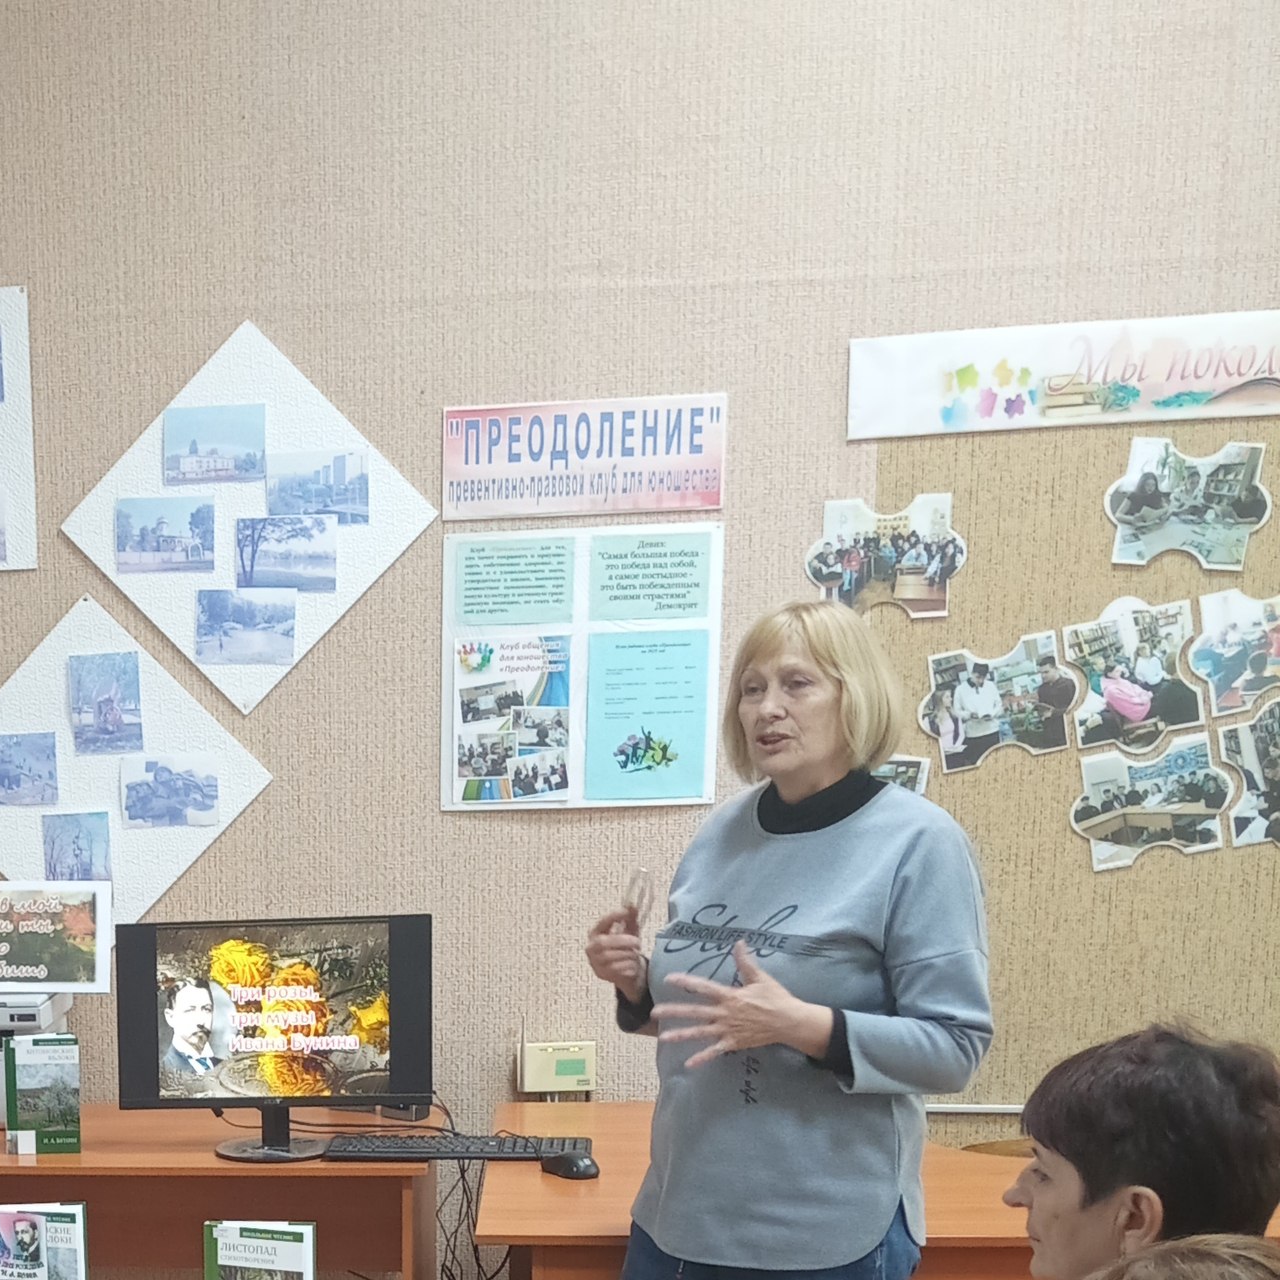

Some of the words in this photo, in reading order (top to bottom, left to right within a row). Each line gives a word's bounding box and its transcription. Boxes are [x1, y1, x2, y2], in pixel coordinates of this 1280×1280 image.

[1047, 333, 1148, 391] Мы
[1165, 343, 1280, 381] покол
[449, 407, 720, 471] "ПРЕОДОЛЕНИЕ"
[448, 468, 585, 510] превентивно-правовой
[589, 464, 618, 503] клуб
[621, 470, 643, 494] для
[647, 467, 719, 493] юношества
[630, 551, 667, 559] большая
[670, 550, 699, 558] победа
[621, 561, 650, 569] победа
[653, 561, 668, 570] над
[670, 560, 697, 568] собой,
[639, 581, 700, 590] побежденным
[642, 591, 691, 600] страстями"
[655, 602, 698, 611] Демокрит
[499, 642, 520, 651] Клуб
[13, 896, 63, 913] мой
[19, 920, 54, 934] ты
[671, 924, 719, 943] FASHION
[746, 932, 789, 948] STYLE
[230, 985, 261, 1003] Три
[265, 986, 320, 1002] розы,
[230, 1013, 261, 1029] три
[265, 1011, 317, 1029] музы
[230, 1036, 287, 1052] Ивана
[291, 1034, 359, 1053] Бунина
[47, 1236, 72, 1244] ЛОКИ
[220, 1242, 277, 1256] ЛИСТОПАД
